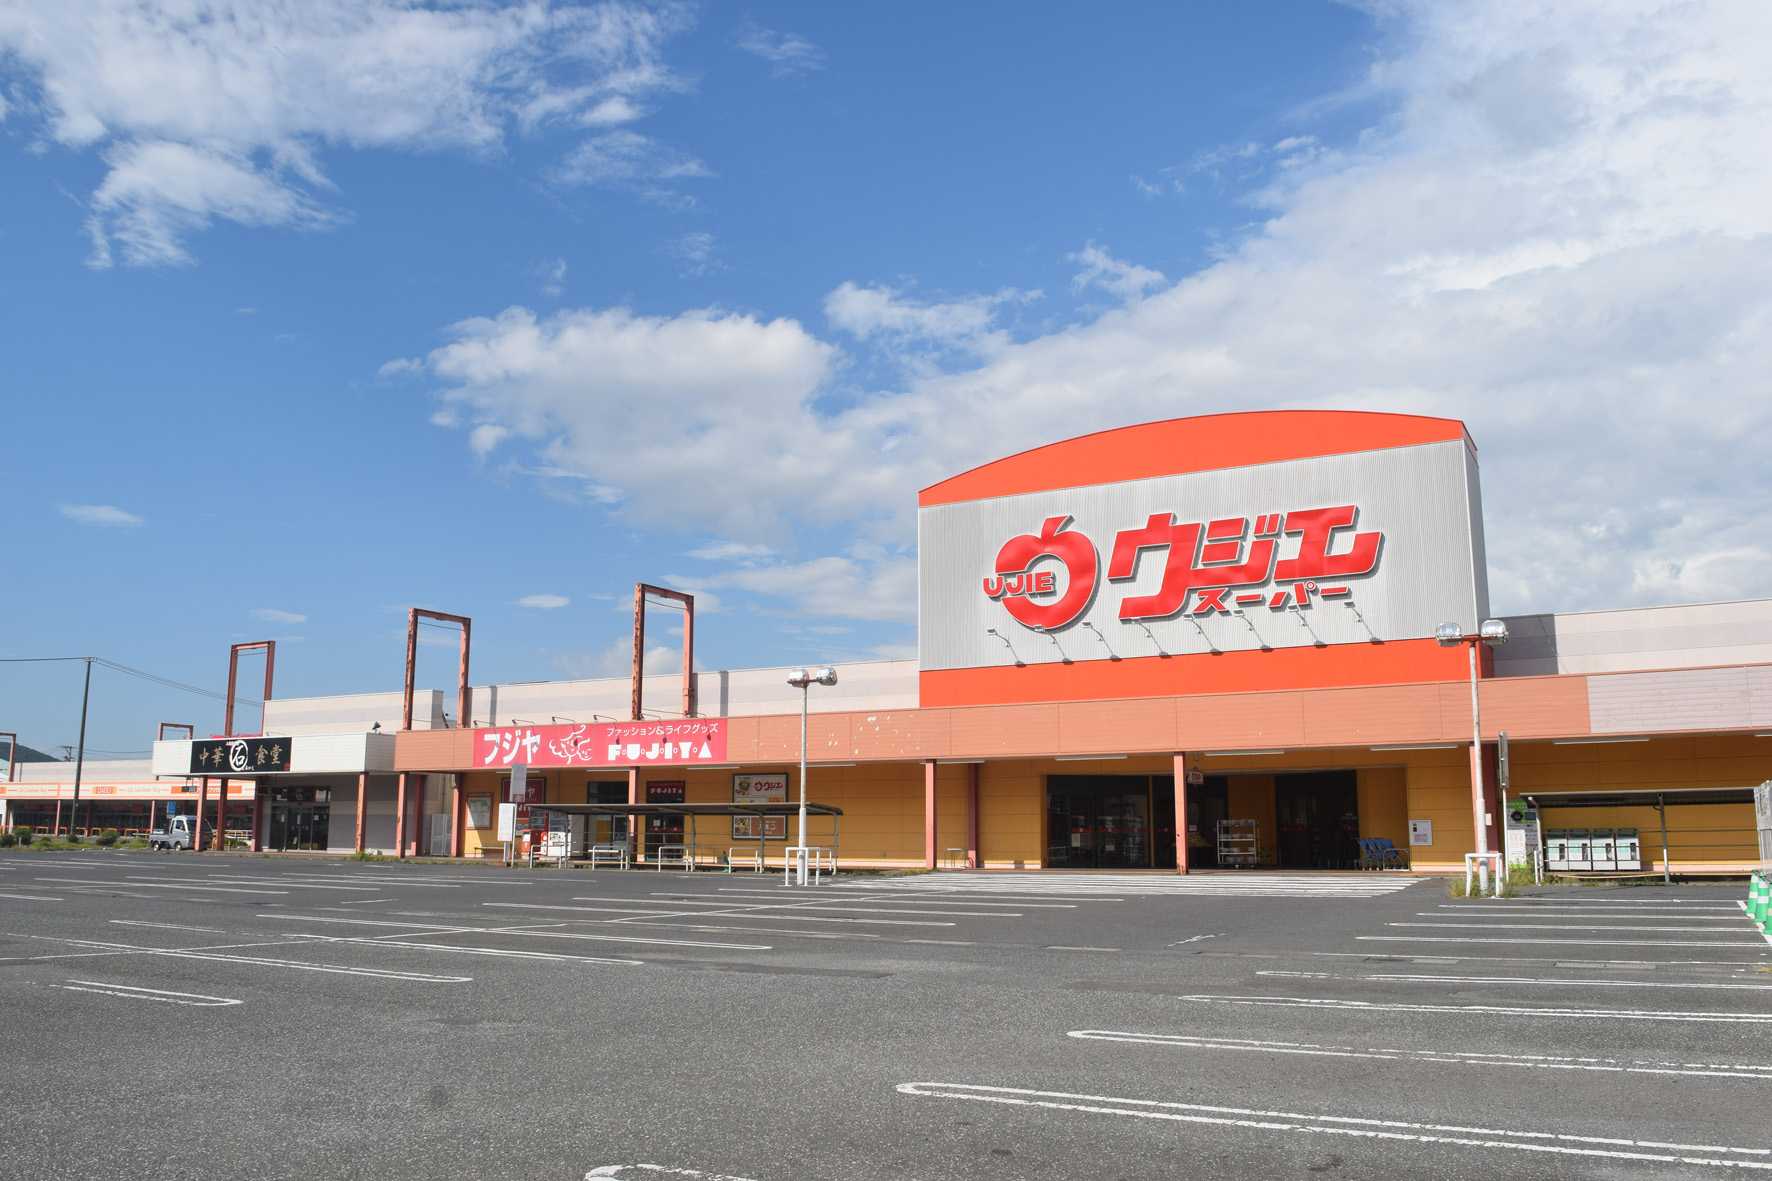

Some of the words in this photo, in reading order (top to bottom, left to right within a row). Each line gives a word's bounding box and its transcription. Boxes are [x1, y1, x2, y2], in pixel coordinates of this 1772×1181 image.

[1108, 504, 1383, 621] ウジエ
[982, 571, 1055, 598] UJIE
[1191, 580, 1352, 615] スーパー
[199, 745, 225, 768] 中華
[255, 744, 283, 765] 食堂
[483, 729, 542, 765] フジヤ
